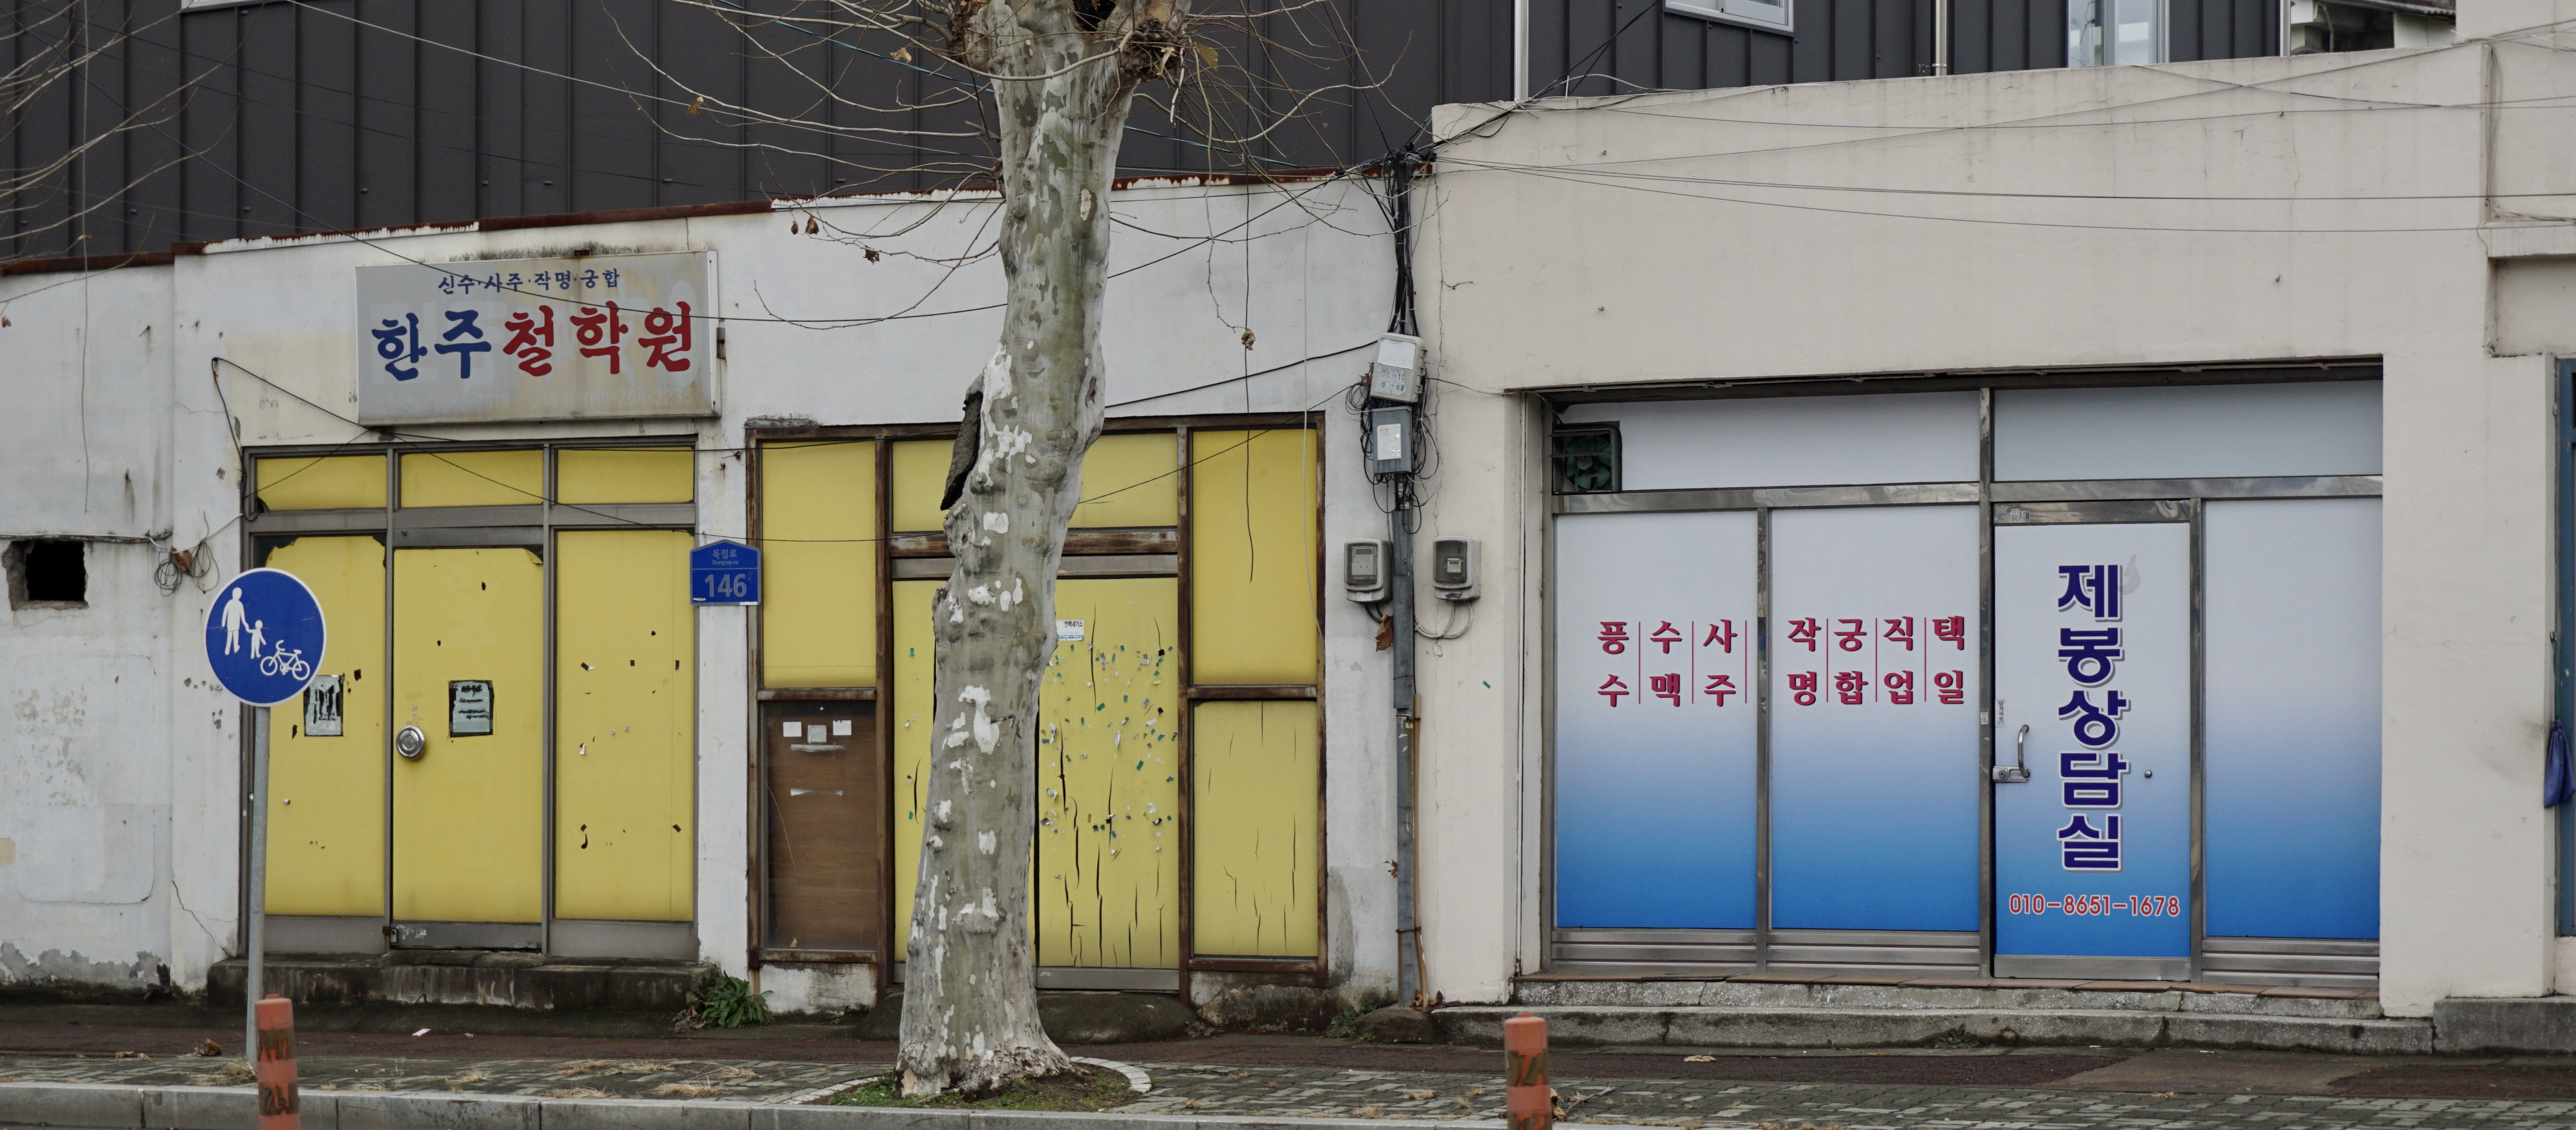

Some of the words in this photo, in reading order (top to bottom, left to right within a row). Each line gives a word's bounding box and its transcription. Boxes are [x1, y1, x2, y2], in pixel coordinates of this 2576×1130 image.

[371, 300, 692, 382] 한주철학원
[704, 573, 747, 597] 146
[712, 549, 737, 560] 독립로
[1598, 621, 1630, 708] 풍수
[1650, 621, 1682, 707] 수맥
[1703, 619, 1737, 707] 사주
[1788, 617, 1821, 706] 작명
[1834, 619, 1868, 705] 궁합
[1883, 616, 1914, 705] 직업
[1932, 615, 1964, 705] 택일
[2058, 565, 2127, 869] 제봉상담실
[2009, 893, 2180, 917] 010-8651-1678
